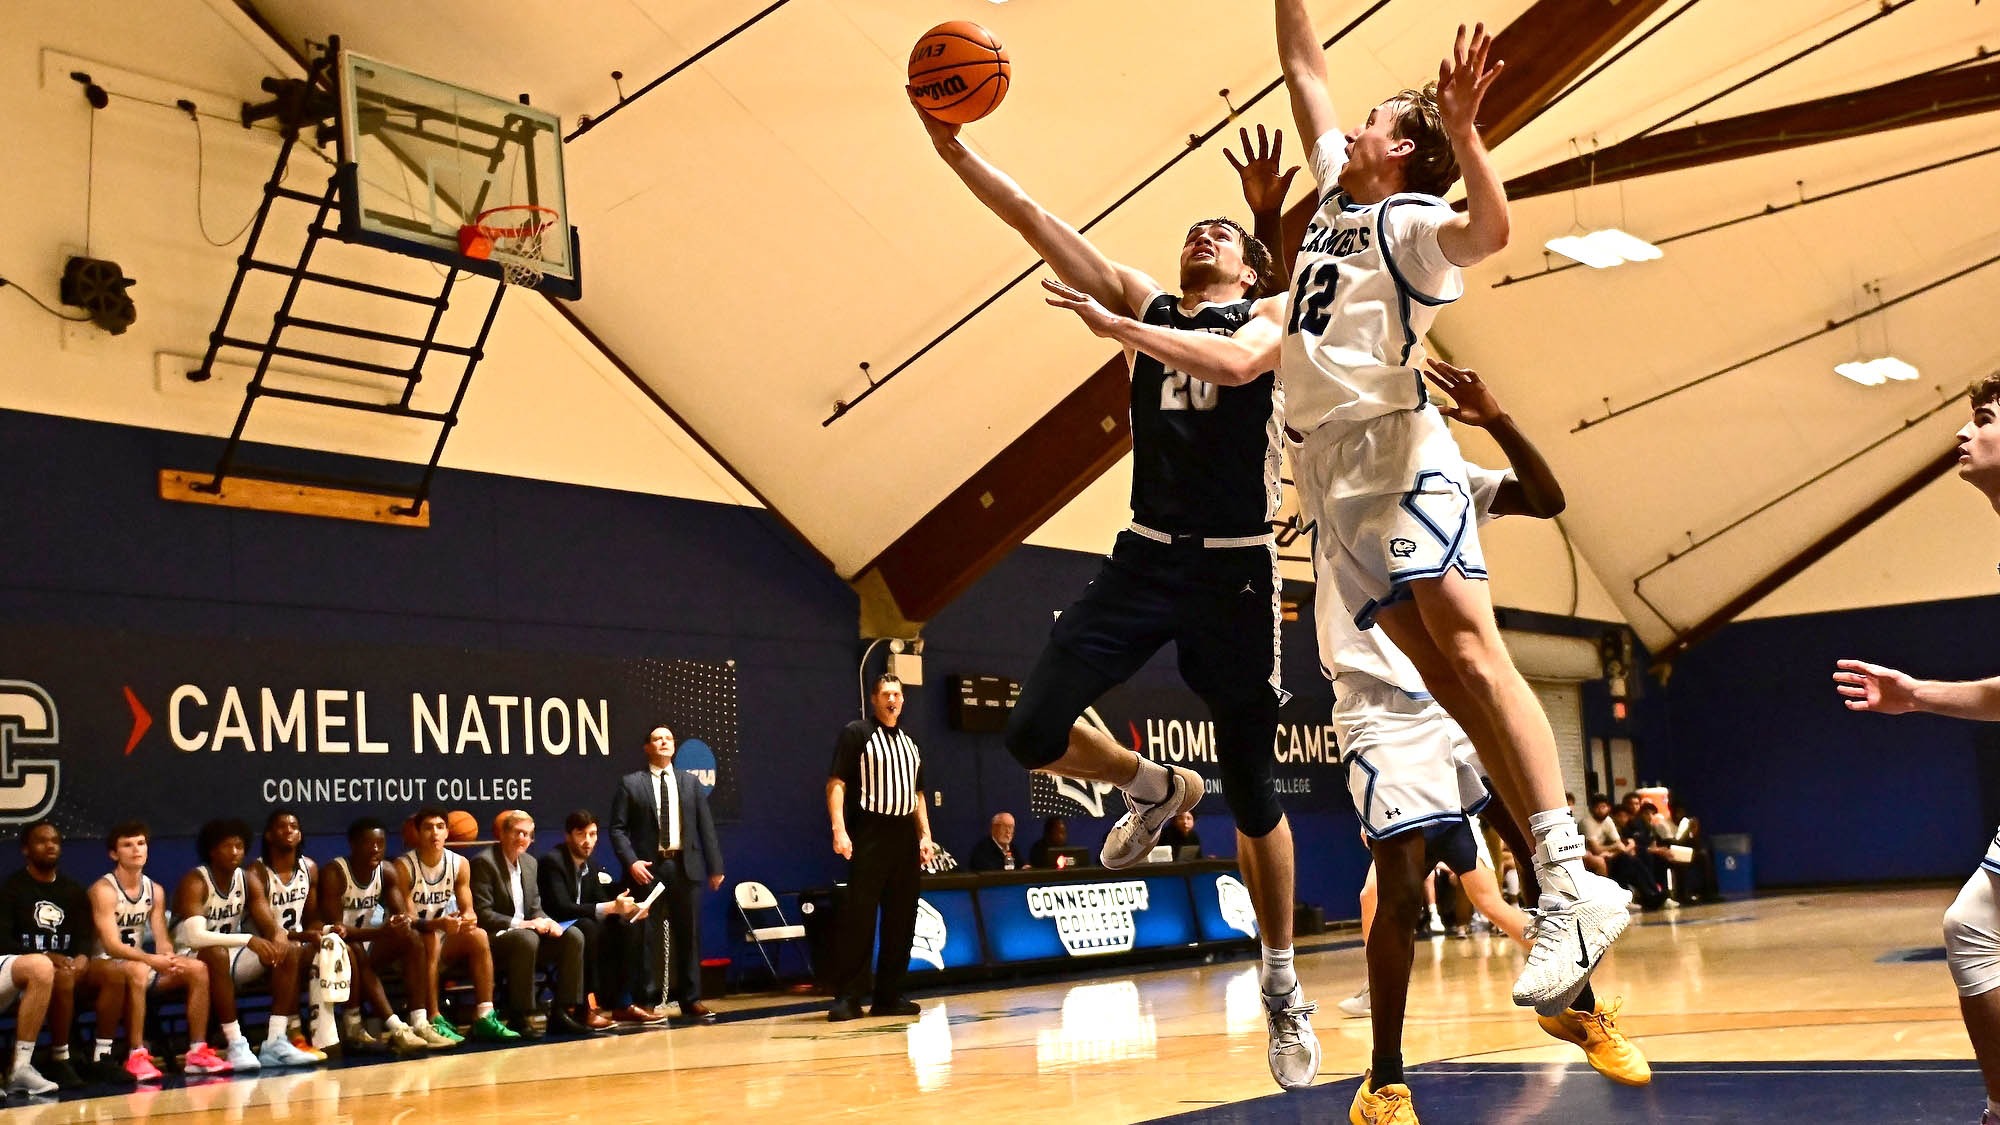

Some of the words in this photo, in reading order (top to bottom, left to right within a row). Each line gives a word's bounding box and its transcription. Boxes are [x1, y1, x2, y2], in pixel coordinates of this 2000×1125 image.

[1287, 263, 1340, 337] 12
[1159, 364, 1219, 411] 20
[168, 683, 389, 754] CAMEL
[412, 691, 610, 756] NATION
[1273, 723, 1344, 764] CAME
[263, 778, 427, 803] CONNECTICUT
[436, 778, 533, 802] COLLEGE
[412, 888, 451, 905] CAMELS
[1031, 885, 1143, 912] CONNECTICUT
[282, 907, 298, 930] 2
[1060, 911, 1130, 934] COLLEGE
[121, 928, 136, 948] 5
